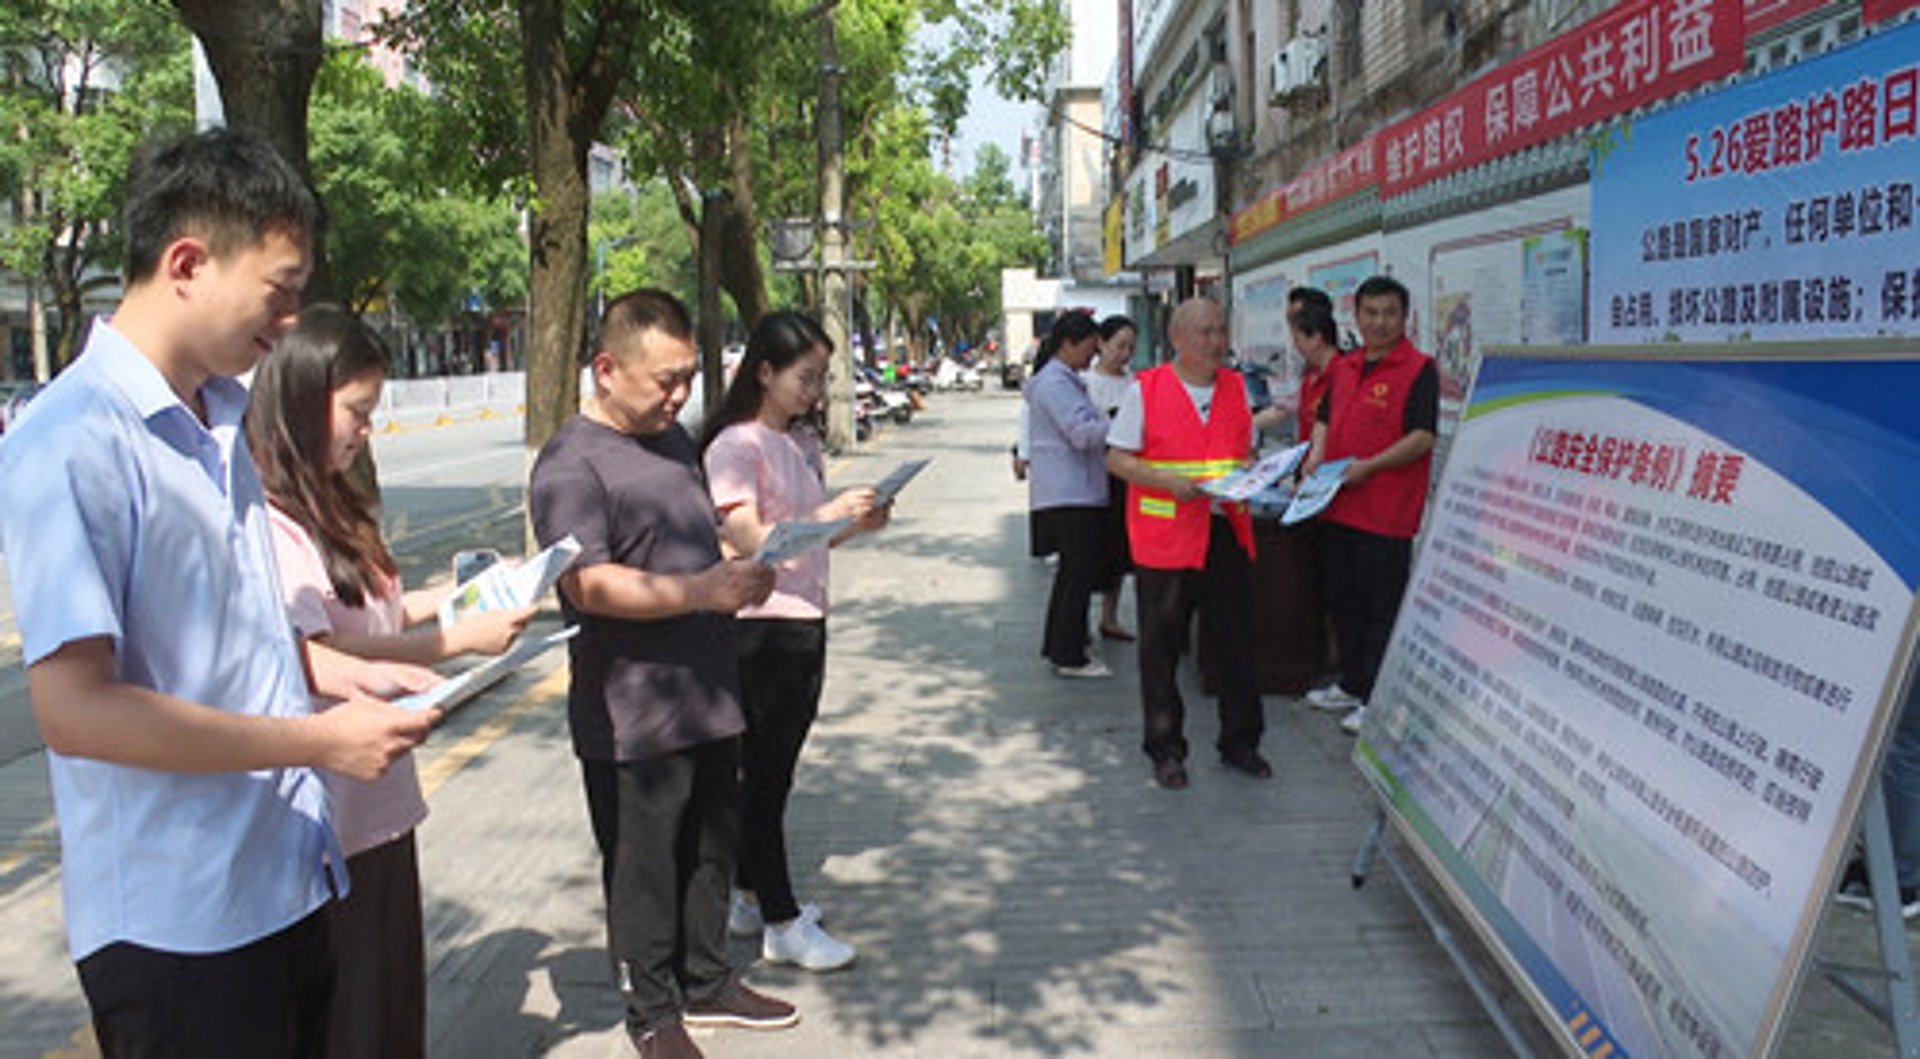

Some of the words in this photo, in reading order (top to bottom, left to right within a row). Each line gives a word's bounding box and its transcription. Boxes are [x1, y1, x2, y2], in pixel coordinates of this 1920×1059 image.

[1386, 106, 1465, 183] 维护路权
[1485, 0, 1715, 144] 保障公共利益
[1685, 68, 1917, 182] 5.26爱路护路日
